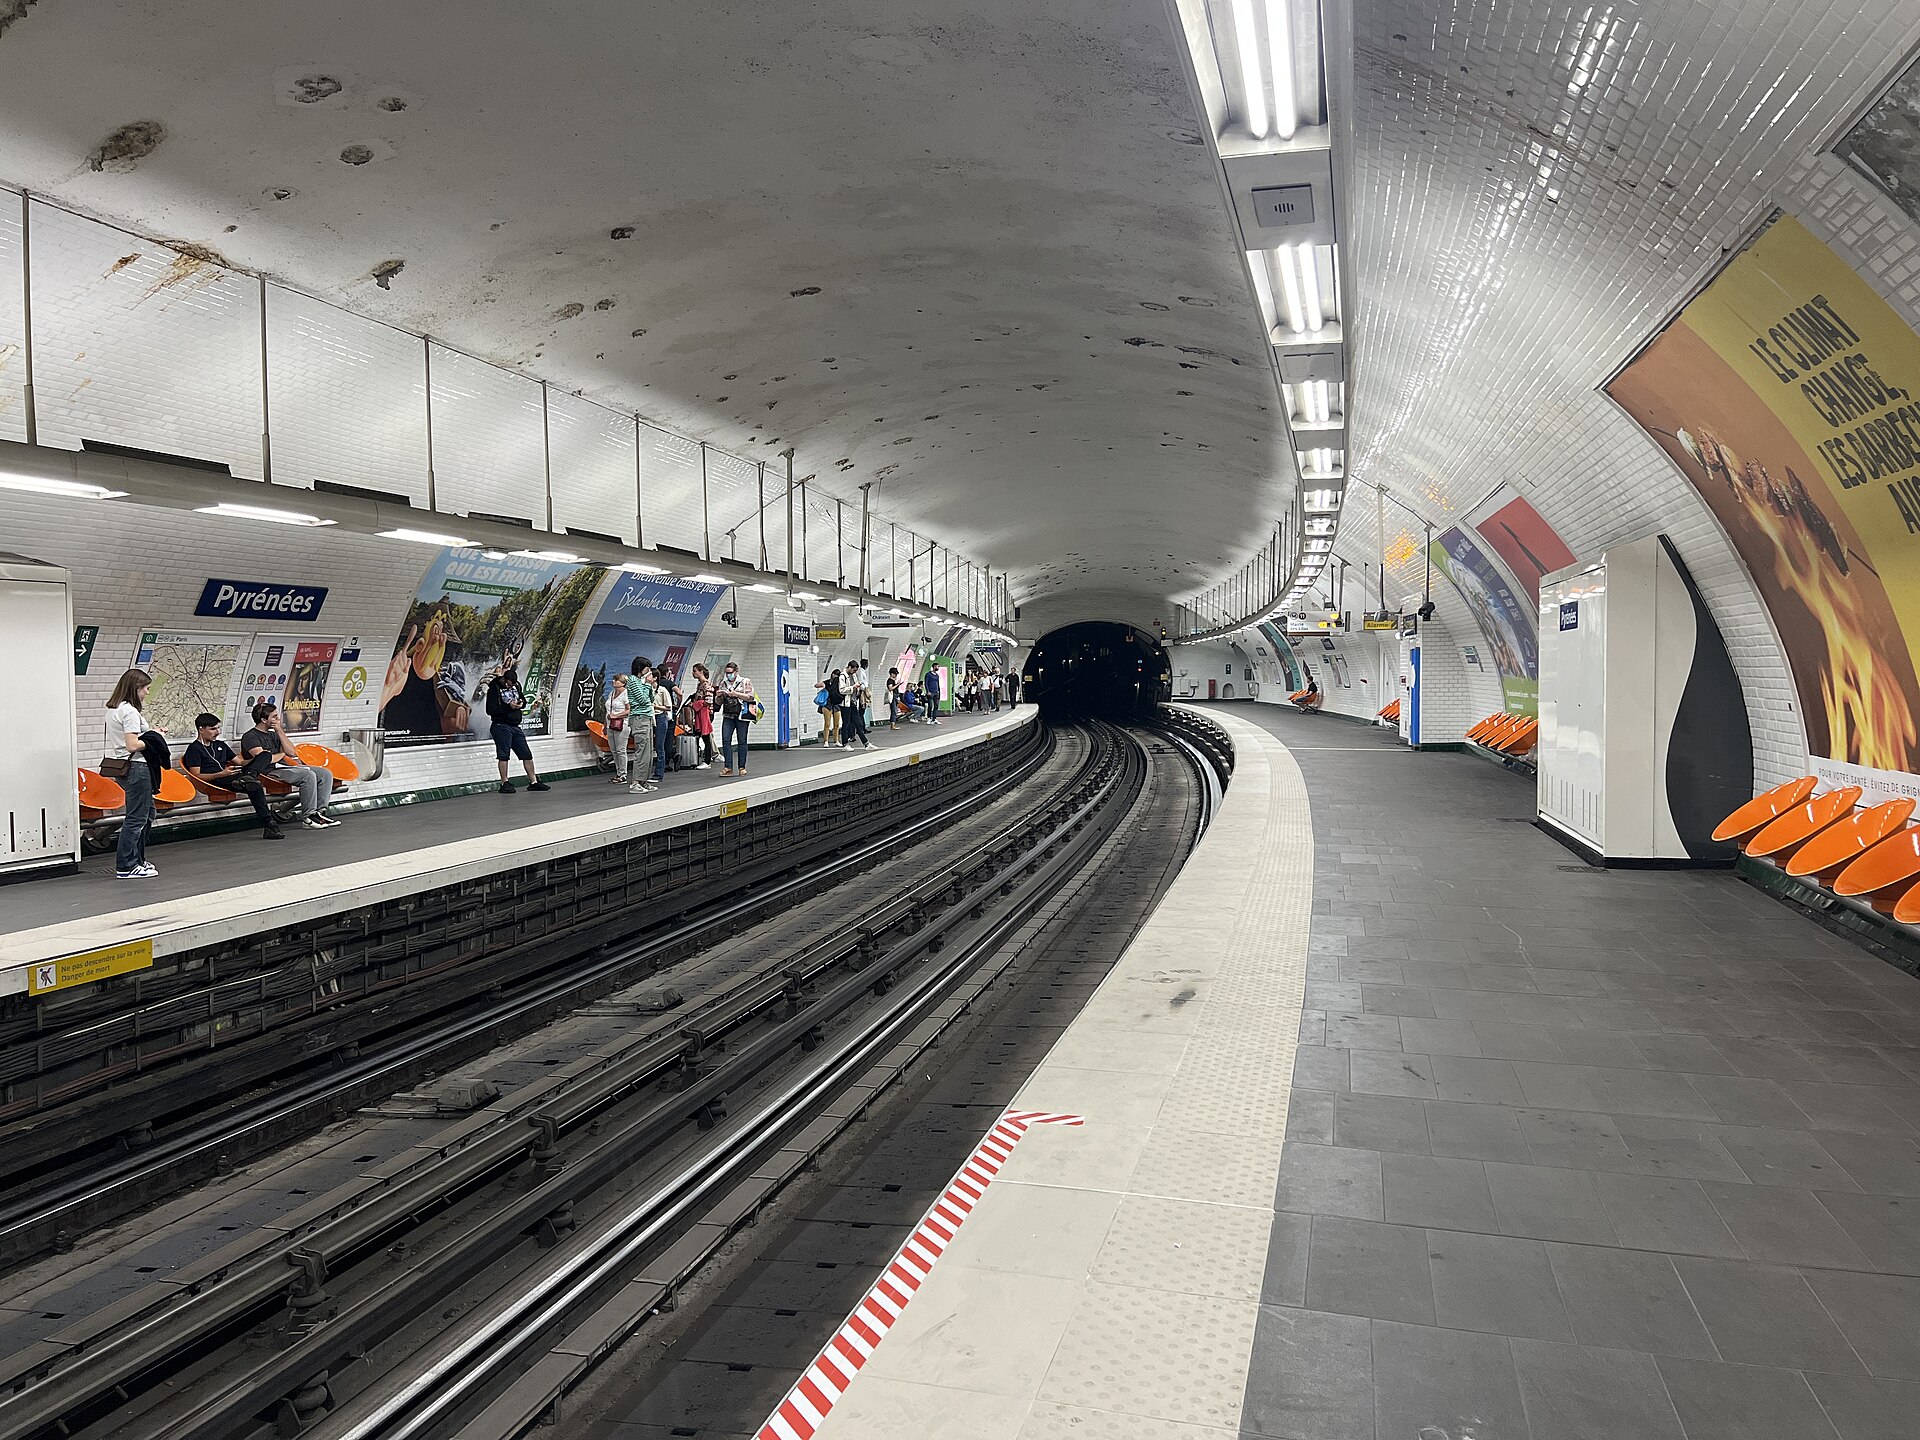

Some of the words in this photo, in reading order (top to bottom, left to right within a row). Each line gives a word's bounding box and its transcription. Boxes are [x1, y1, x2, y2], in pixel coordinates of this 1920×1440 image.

[1768, 294, 1861, 371] CLIMAT
[1748, 337, 1799, 384] LE
[1800, 353, 1910, 428] CHANGE,
[1816, 437, 1868, 489] LES
[445, 561, 474, 577] QUI
[472, 565, 500, 580] EST
[500, 569, 539, 585] FRAIS
[213, 584, 315, 615] Pyrénées
[614, 585, 662, 613] Belambra
[662, 598, 673, 611] du
[673, 602, 701, 615] monde
[787, 626, 809, 643] Pyrénées
[1818, 767, 1832, 778] POUR
[1833, 771, 1849, 783] VOTRE
[1871, 778, 1890, 793] ÉVITEZ
[1891, 782, 1899, 793] DE
[61, 965, 71, 973] Ne
[72, 963, 84, 972] pas
[84, 955, 116, 968] descendre
[116, 952, 127, 960] sur
[126, 949, 133, 957] la
[133, 947, 146, 955] voie
[61, 970, 85, 982] Danger
[95, 965, 110, 974] mort
